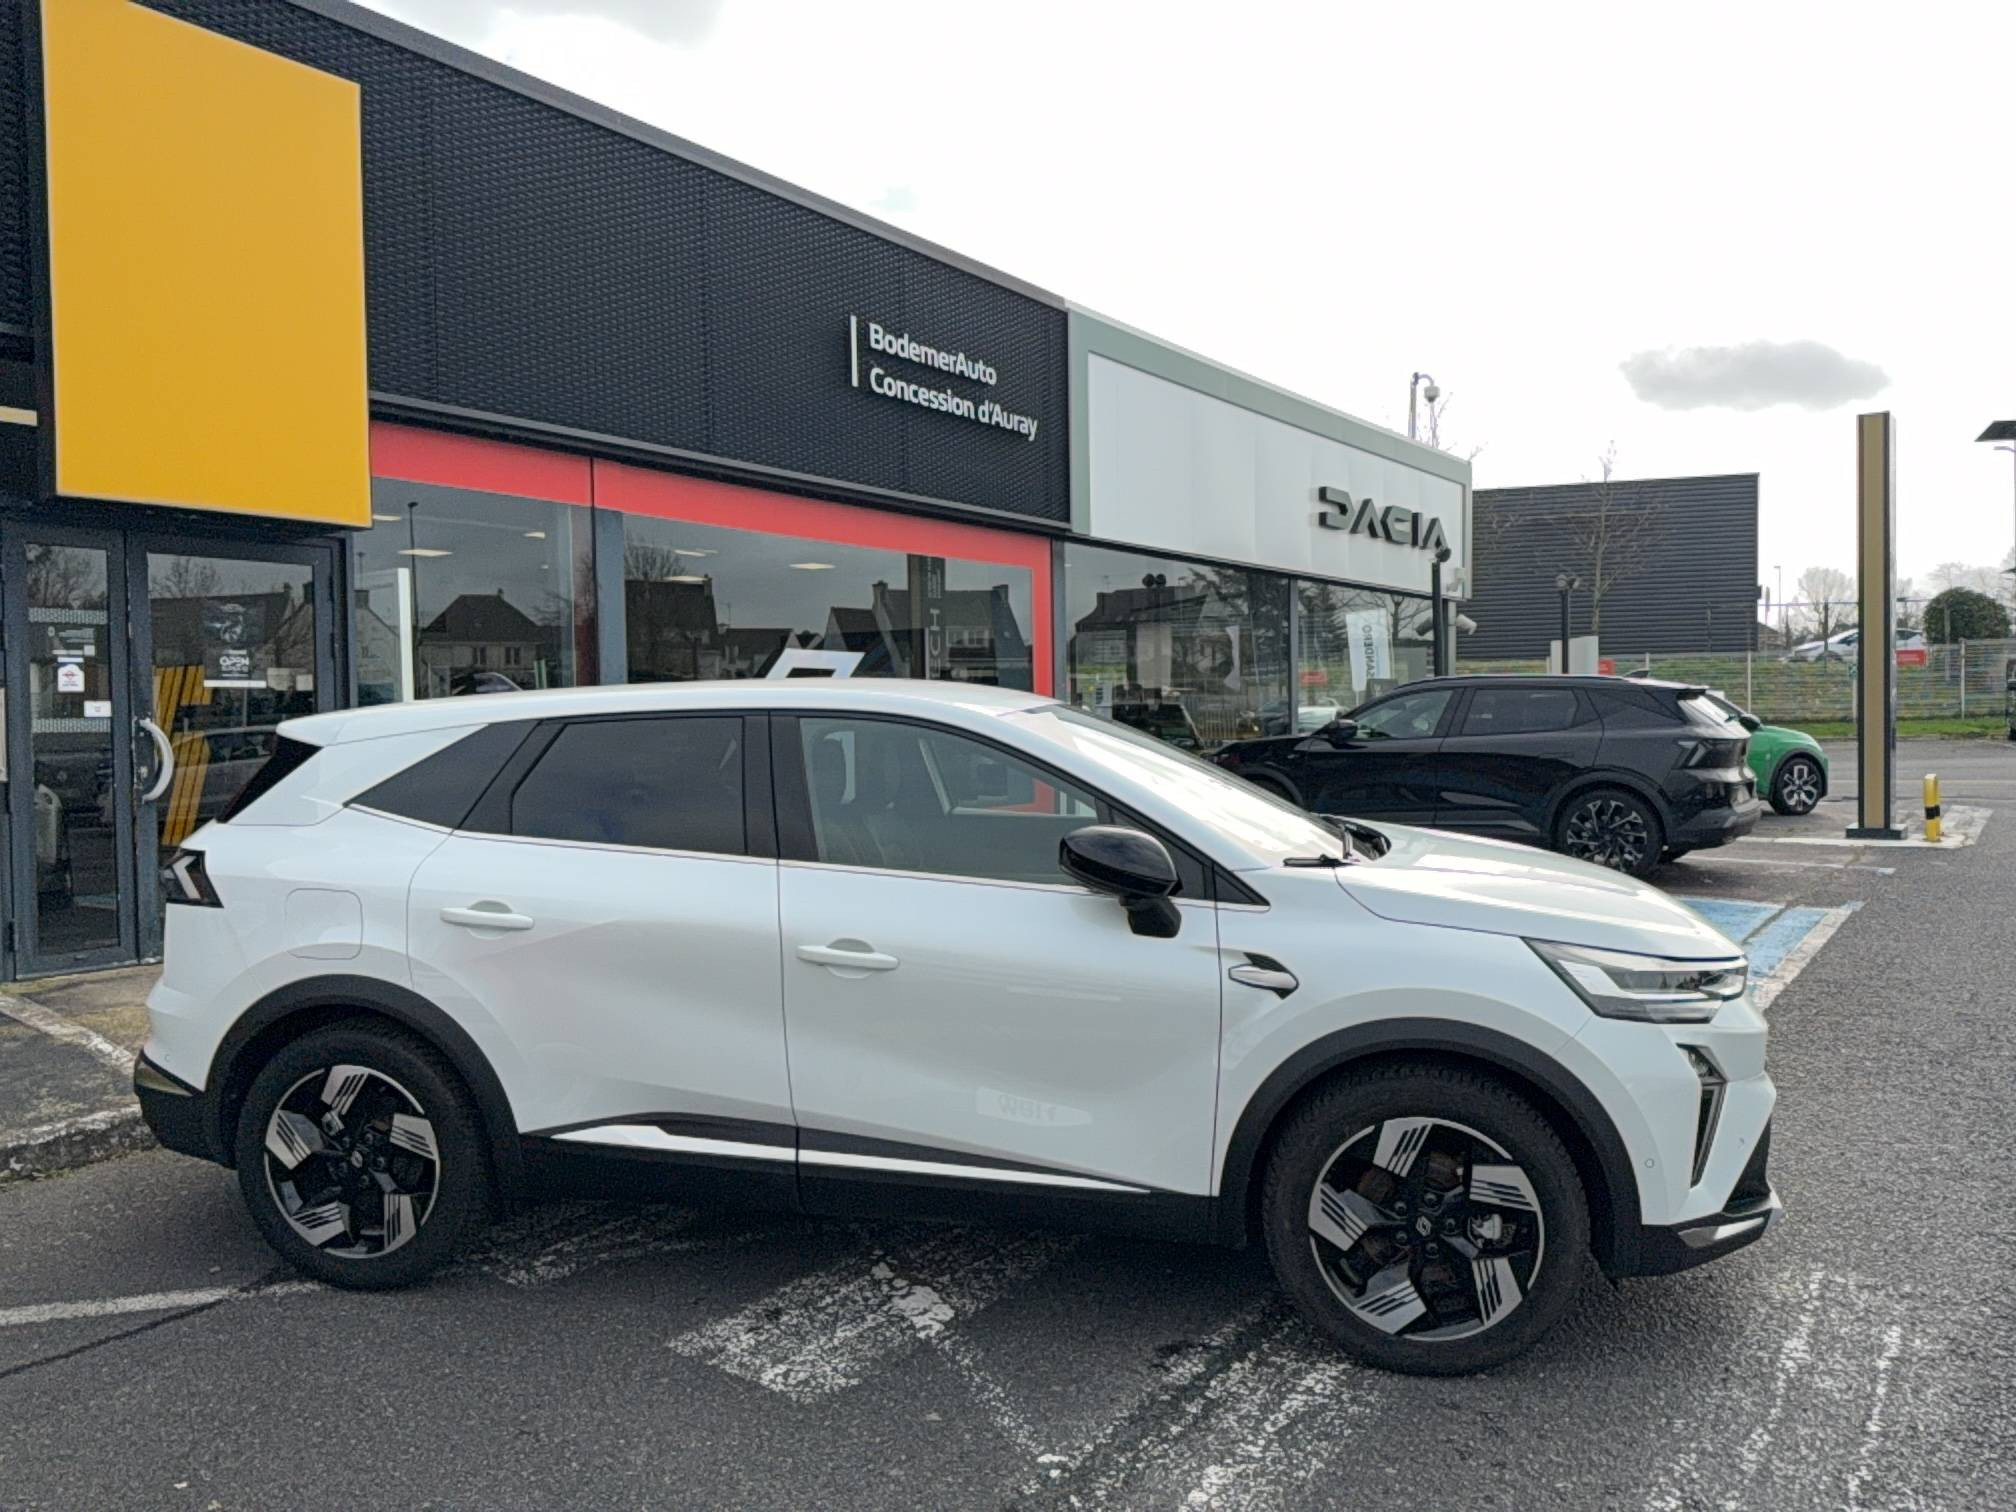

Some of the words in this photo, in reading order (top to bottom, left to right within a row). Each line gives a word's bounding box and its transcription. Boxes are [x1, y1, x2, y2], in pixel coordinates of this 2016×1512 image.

[868, 322, 997, 386] BodemerAuto
[870, 367, 976, 420] Concession
[977, 399, 1038, 442] d'Auray
[1318, 486, 1450, 550] DACIA
